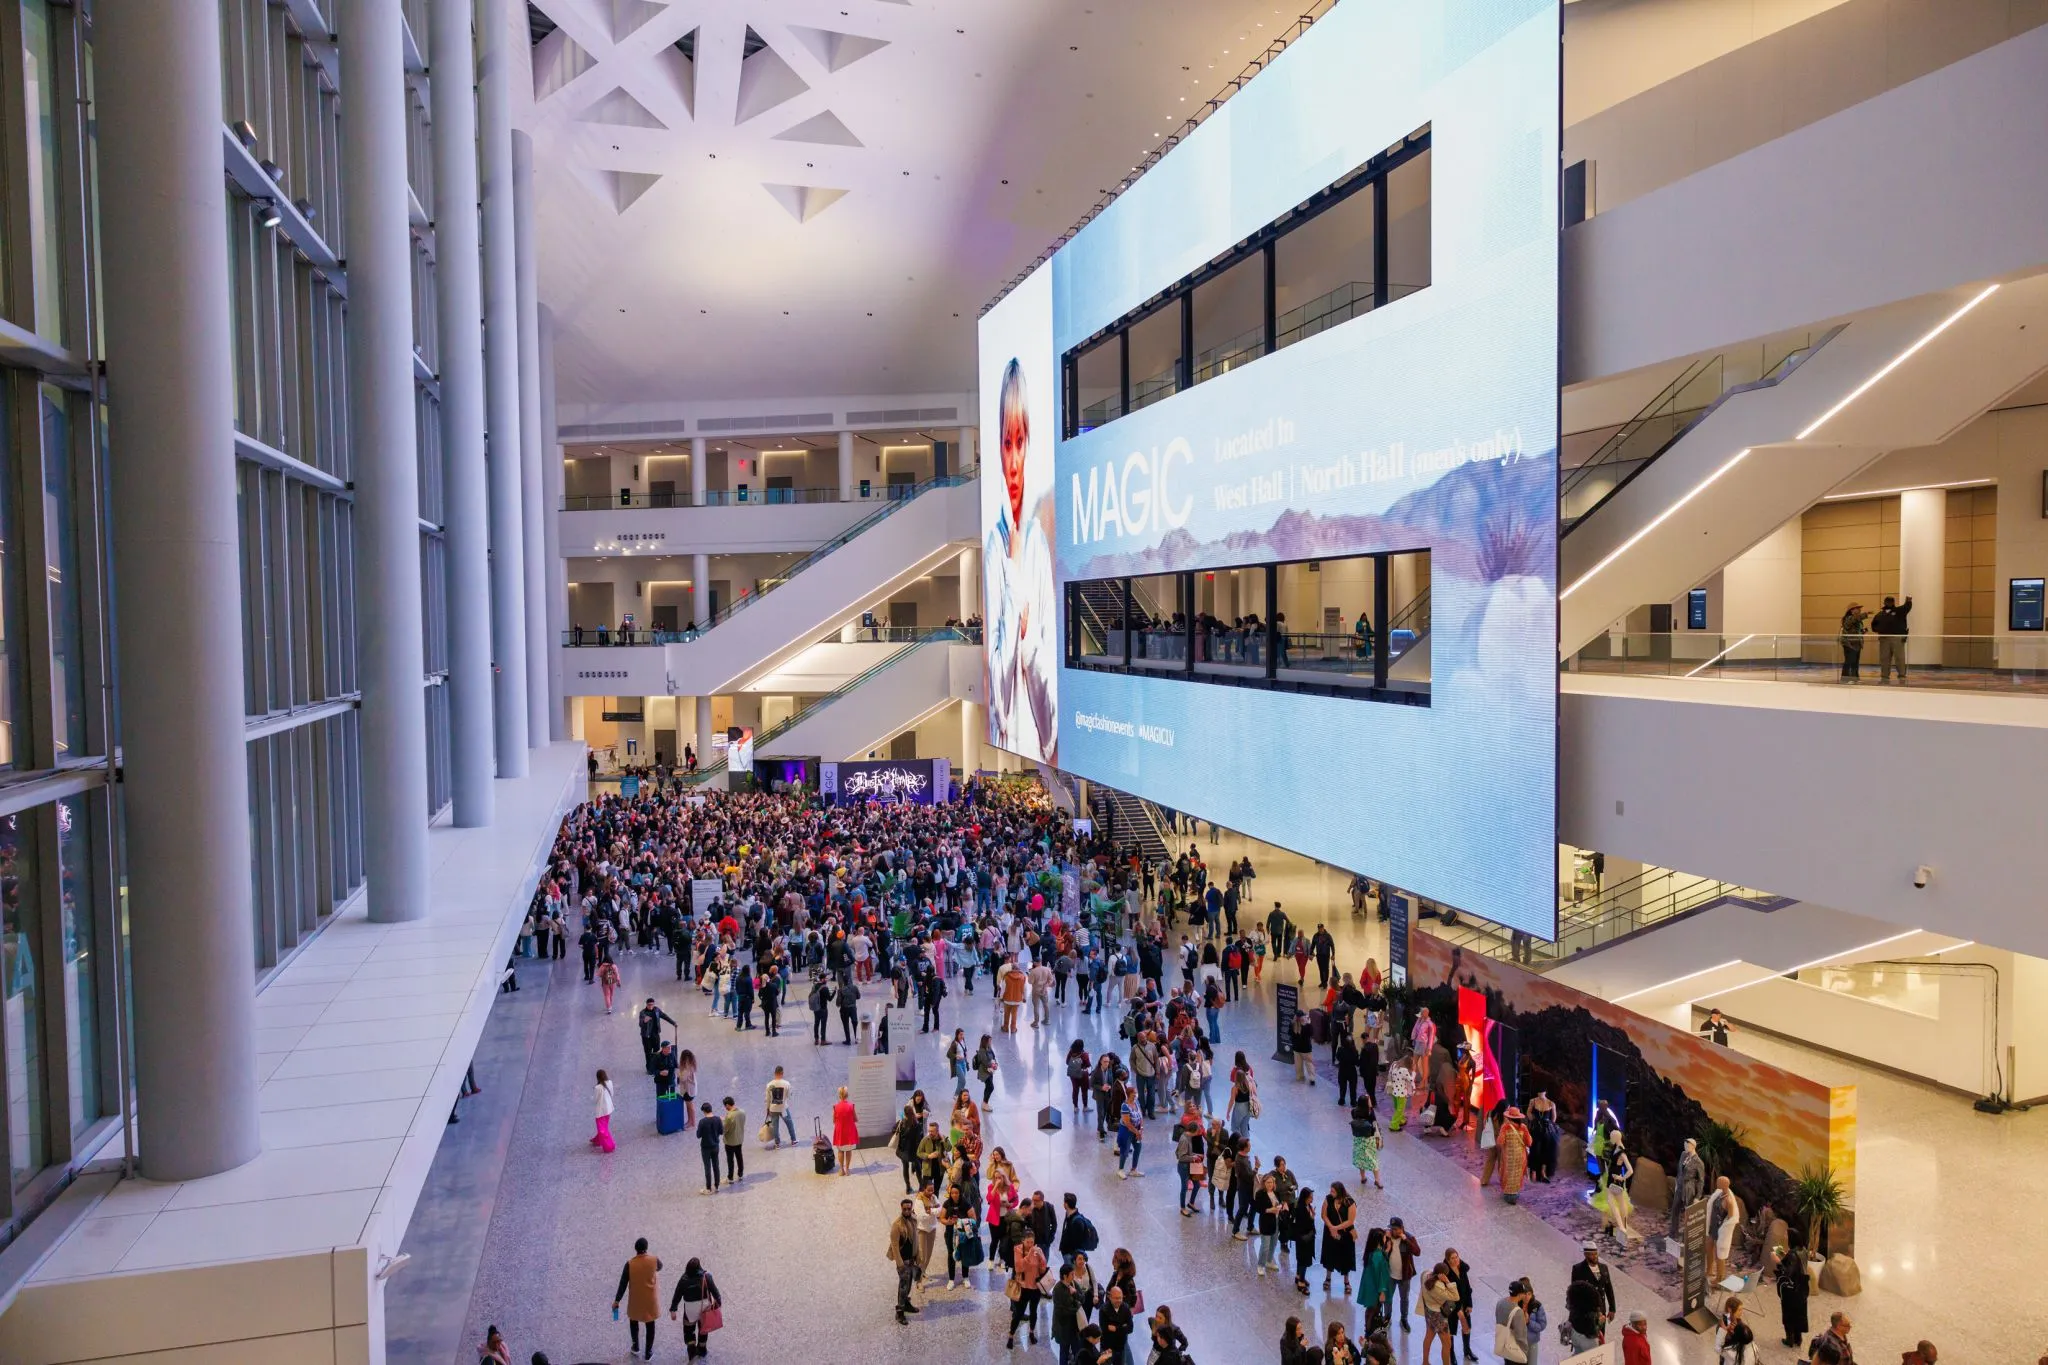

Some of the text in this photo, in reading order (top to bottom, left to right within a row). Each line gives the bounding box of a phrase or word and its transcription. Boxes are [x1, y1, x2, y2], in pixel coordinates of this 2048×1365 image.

[1215, 415, 1295, 463] Located In
[1072, 436, 1194, 545] MAGIC
[1214, 482, 1249, 512] West
[1251, 469, 1283, 505] Hall
[1302, 459, 1354, 495] North
[1360, 441, 1404, 484] Hall
[1411, 438, 1467, 480] (men's
[1471, 427, 1523, 466] only)
[1075, 710, 1175, 746] @magicfashionevents #MAGICLV
[824, 771, 834, 793] AGIC
